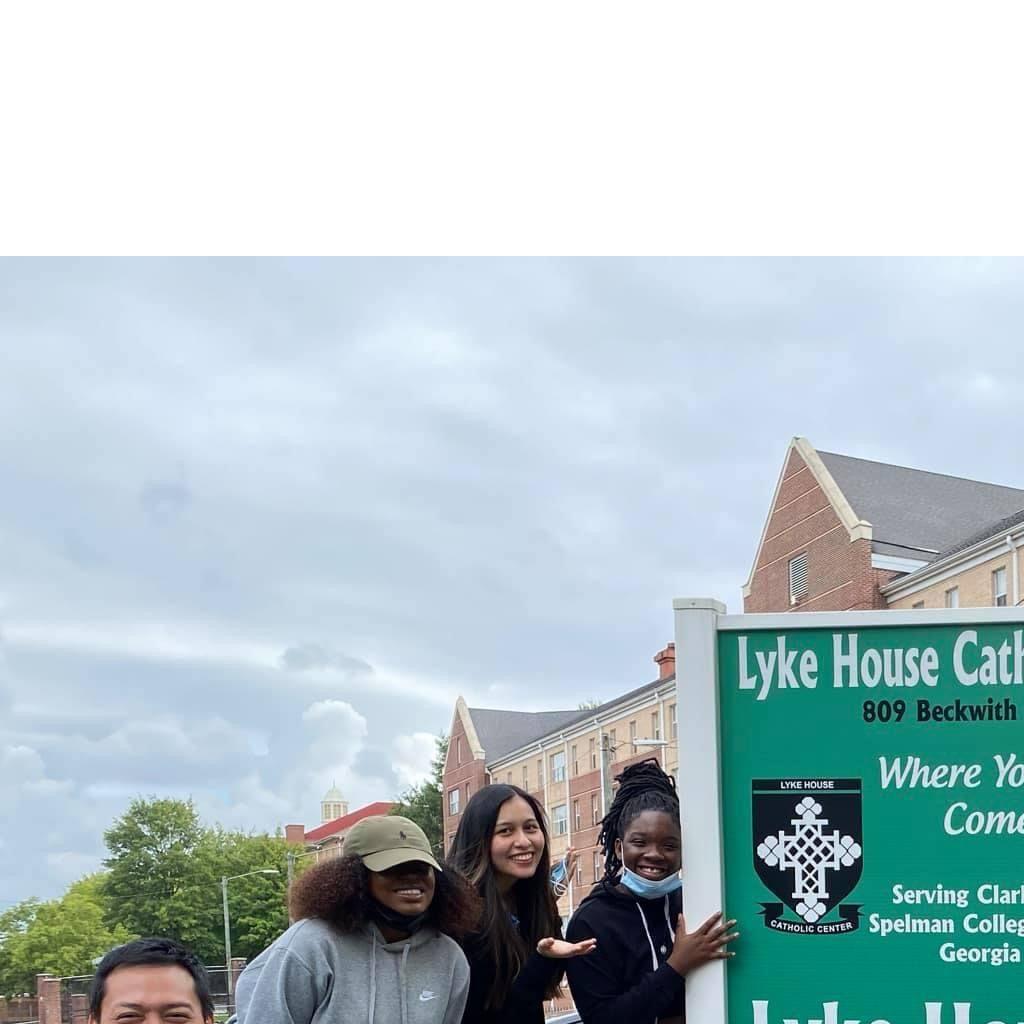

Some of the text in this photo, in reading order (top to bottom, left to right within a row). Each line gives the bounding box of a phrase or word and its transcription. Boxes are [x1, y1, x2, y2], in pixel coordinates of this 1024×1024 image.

[738, 635, 818, 701] Lyke
[832, 633, 939, 688] House
[862, 699, 906, 723] 809
[916, 697, 1017, 722] Beckwith
[878, 755, 982, 789] Where
[780, 780, 835, 789] LYKE HOUSE
[892, 884, 970, 908] Serving
[770, 919, 853, 933] CATHOLIC CENTER
[869, 913, 955, 937] Spelman
[939, 942, 1021, 966] Georgia
